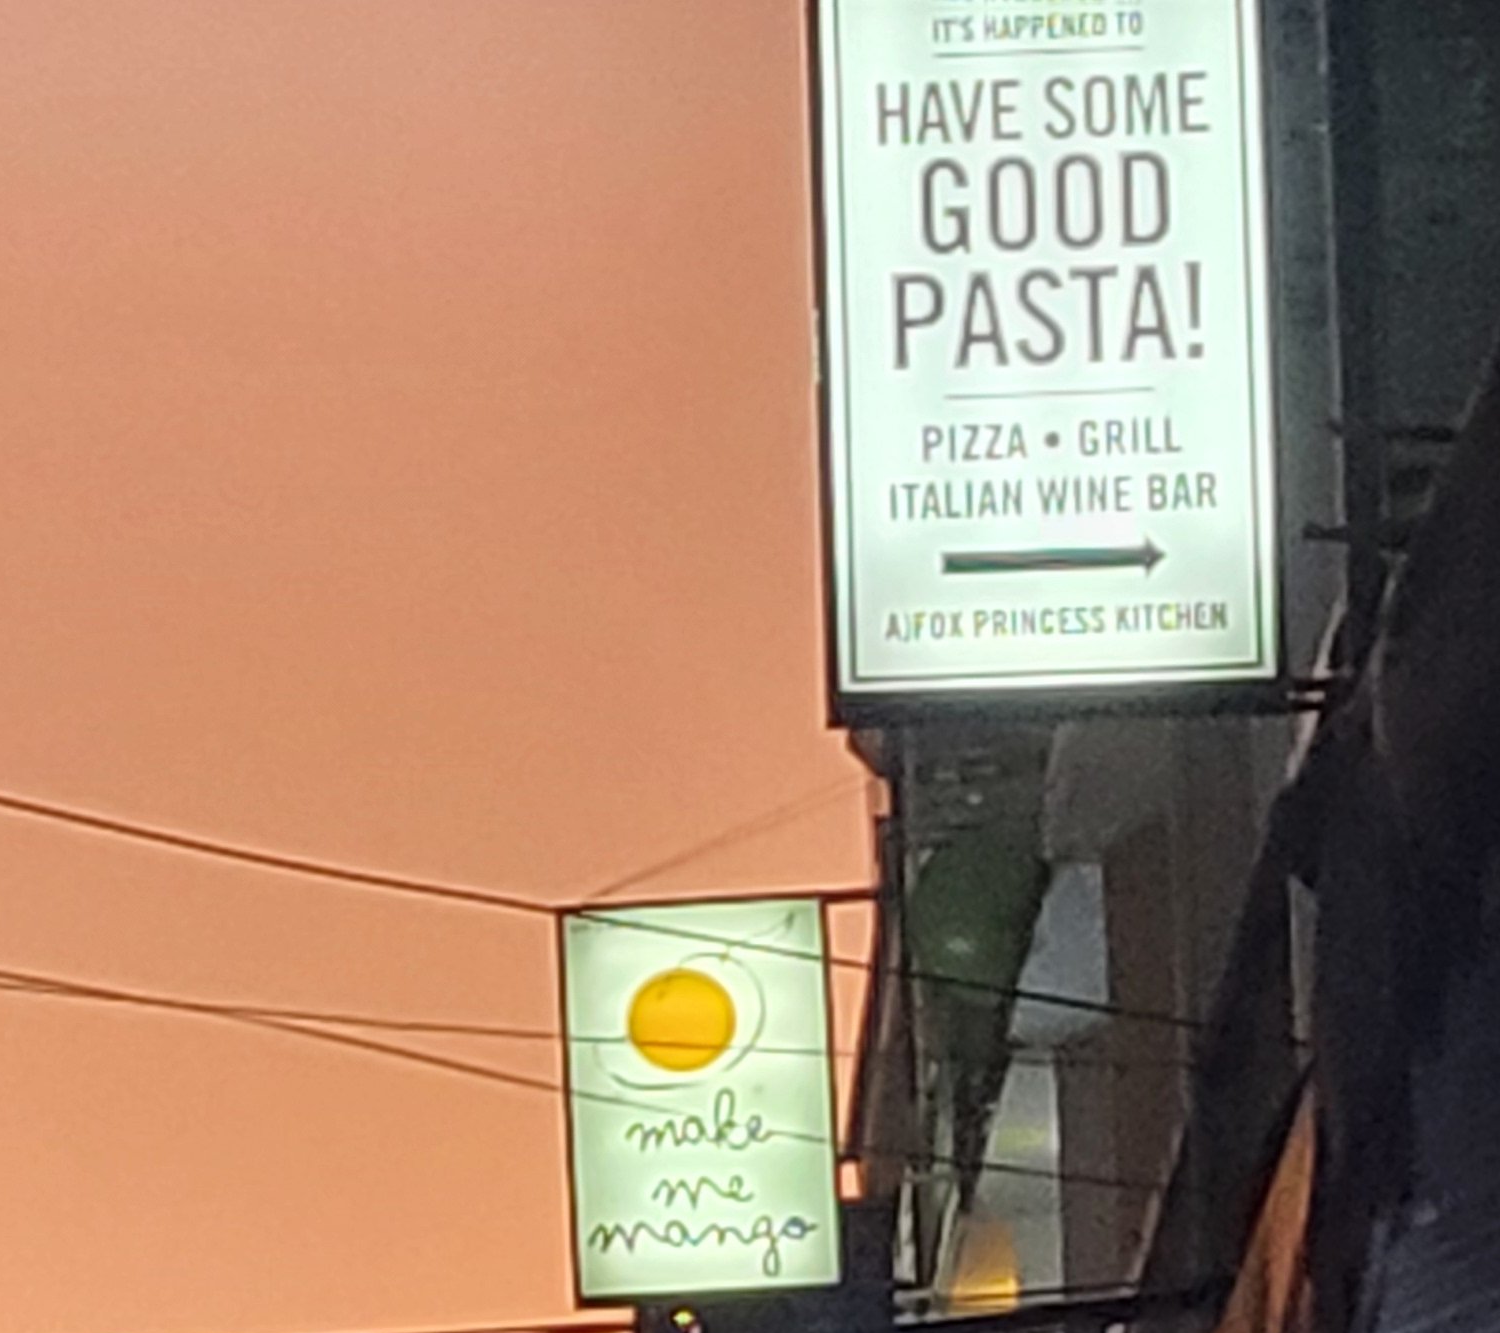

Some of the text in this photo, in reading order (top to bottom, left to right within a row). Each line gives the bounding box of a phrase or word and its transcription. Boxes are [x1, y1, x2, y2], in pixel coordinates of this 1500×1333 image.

[984, 12, 1107, 41] HAPPENED
[1116, 11, 1144, 35] TO
[876, 71, 1211, 146] HAVE SOME
[921, 151, 1170, 254] GOOD
[891, 261, 1206, 370] PASTA!
[921, 416, 1183, 461] PIZZA GRILL
[889, 472, 1218, 520] ITALIAN WINE BAR
[973, 606, 1106, 638] PRINCESS
[1116, 603, 1228, 632] KITCHEN
[625, 1087, 771, 1151] make
[652, 1174, 755, 1210] me
[588, 1214, 819, 1278] mango
